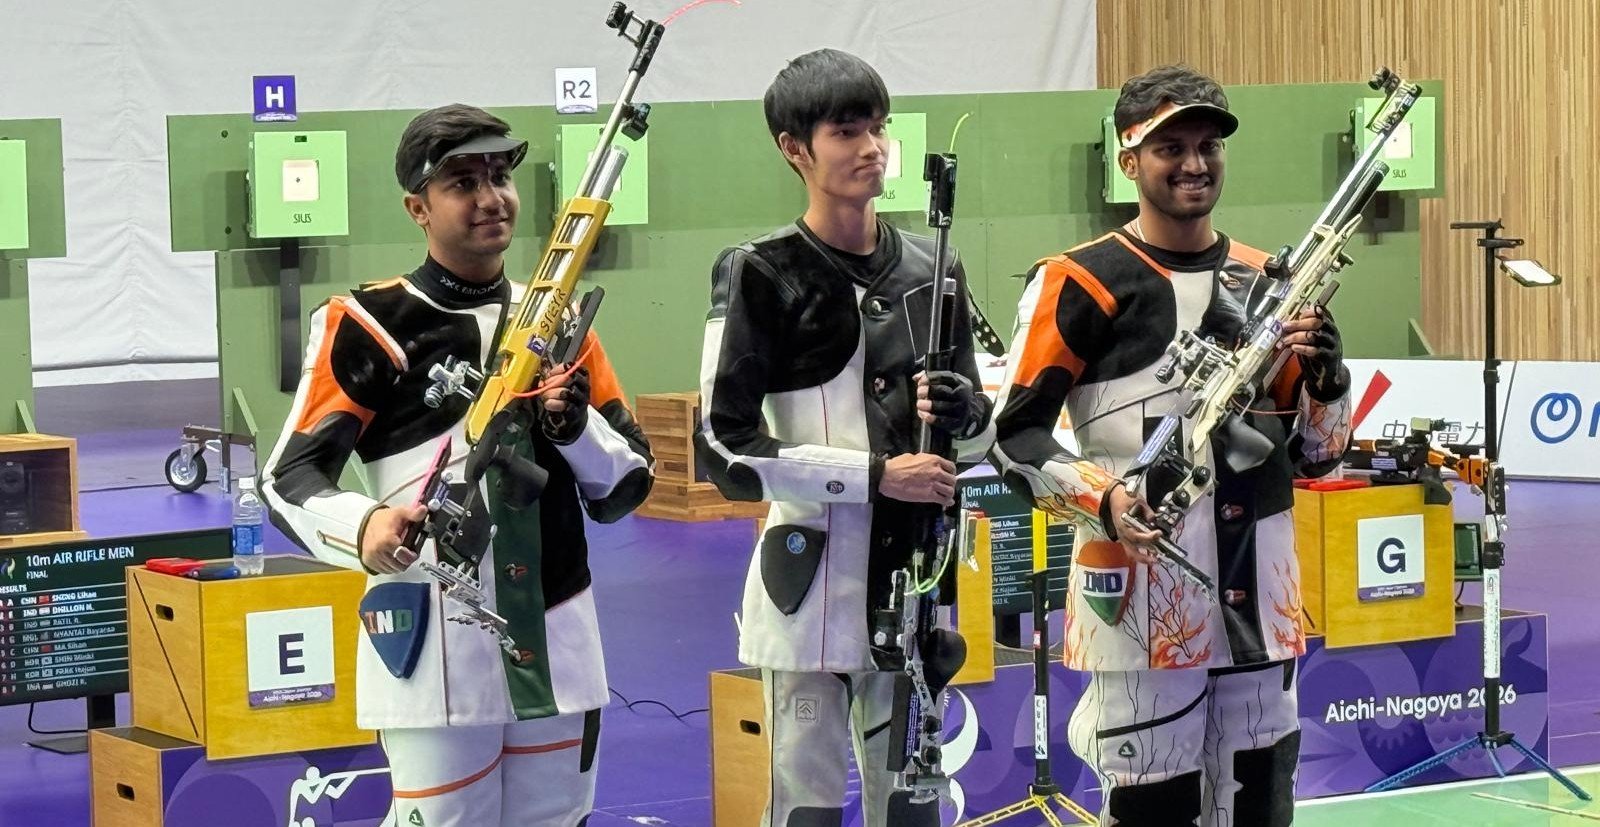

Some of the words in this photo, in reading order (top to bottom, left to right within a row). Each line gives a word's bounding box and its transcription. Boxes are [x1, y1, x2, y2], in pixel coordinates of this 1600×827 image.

[265, 85, 284, 108] H
[563, 80, 592, 99] R2
[293, 213, 312, 224] SIUS
[1382, 419, 1485, 445] 中電力
[983, 483, 1000, 496] AIR
[26, 554, 51, 567] 10m
[53, 551, 73, 565] AIR
[75, 548, 106, 562] RIFLE
[108, 546, 135, 559] MEN
[1376, 537, 1406, 574] G
[26, 570, 49, 580] FINAL
[1083, 571, 1123, 593] IND
[52, 604, 86, 614] DHILLON
[364, 609, 414, 634] IND
[279, 632, 305, 675] E
[1, 673, 7, 682] 7
[1325, 692, 1462, 724] Aichi-Nagoya
